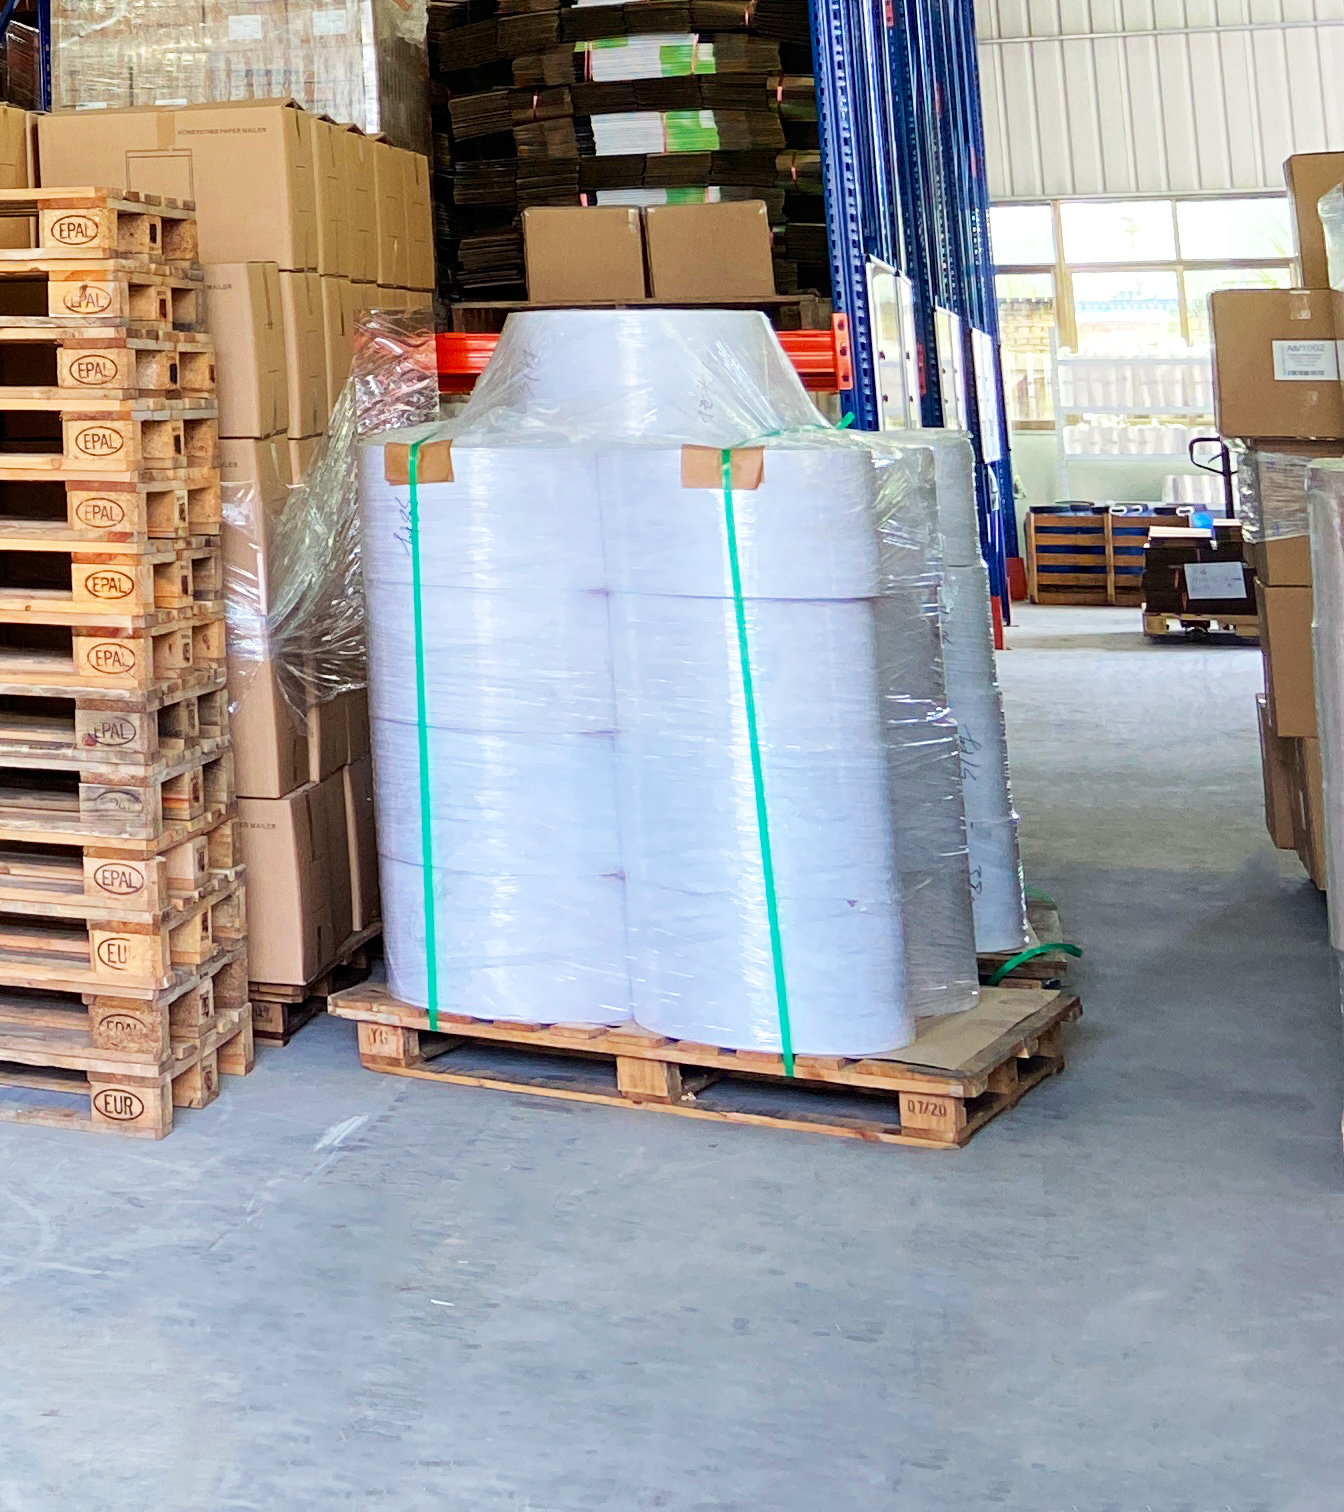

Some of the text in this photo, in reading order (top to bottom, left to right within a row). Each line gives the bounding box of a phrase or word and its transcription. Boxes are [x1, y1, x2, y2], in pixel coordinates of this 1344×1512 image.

[59, 222, 94, 240] EPAL
[78, 362, 112, 379] EPAL
[84, 433, 118, 450] EPAL
[84, 504, 118, 521] EPAL
[92, 576, 129, 594] EPAL
[96, 650, 130, 667] EPAL
[102, 869, 137, 889] EPAL
[104, 1094, 133, 1116] EUR
